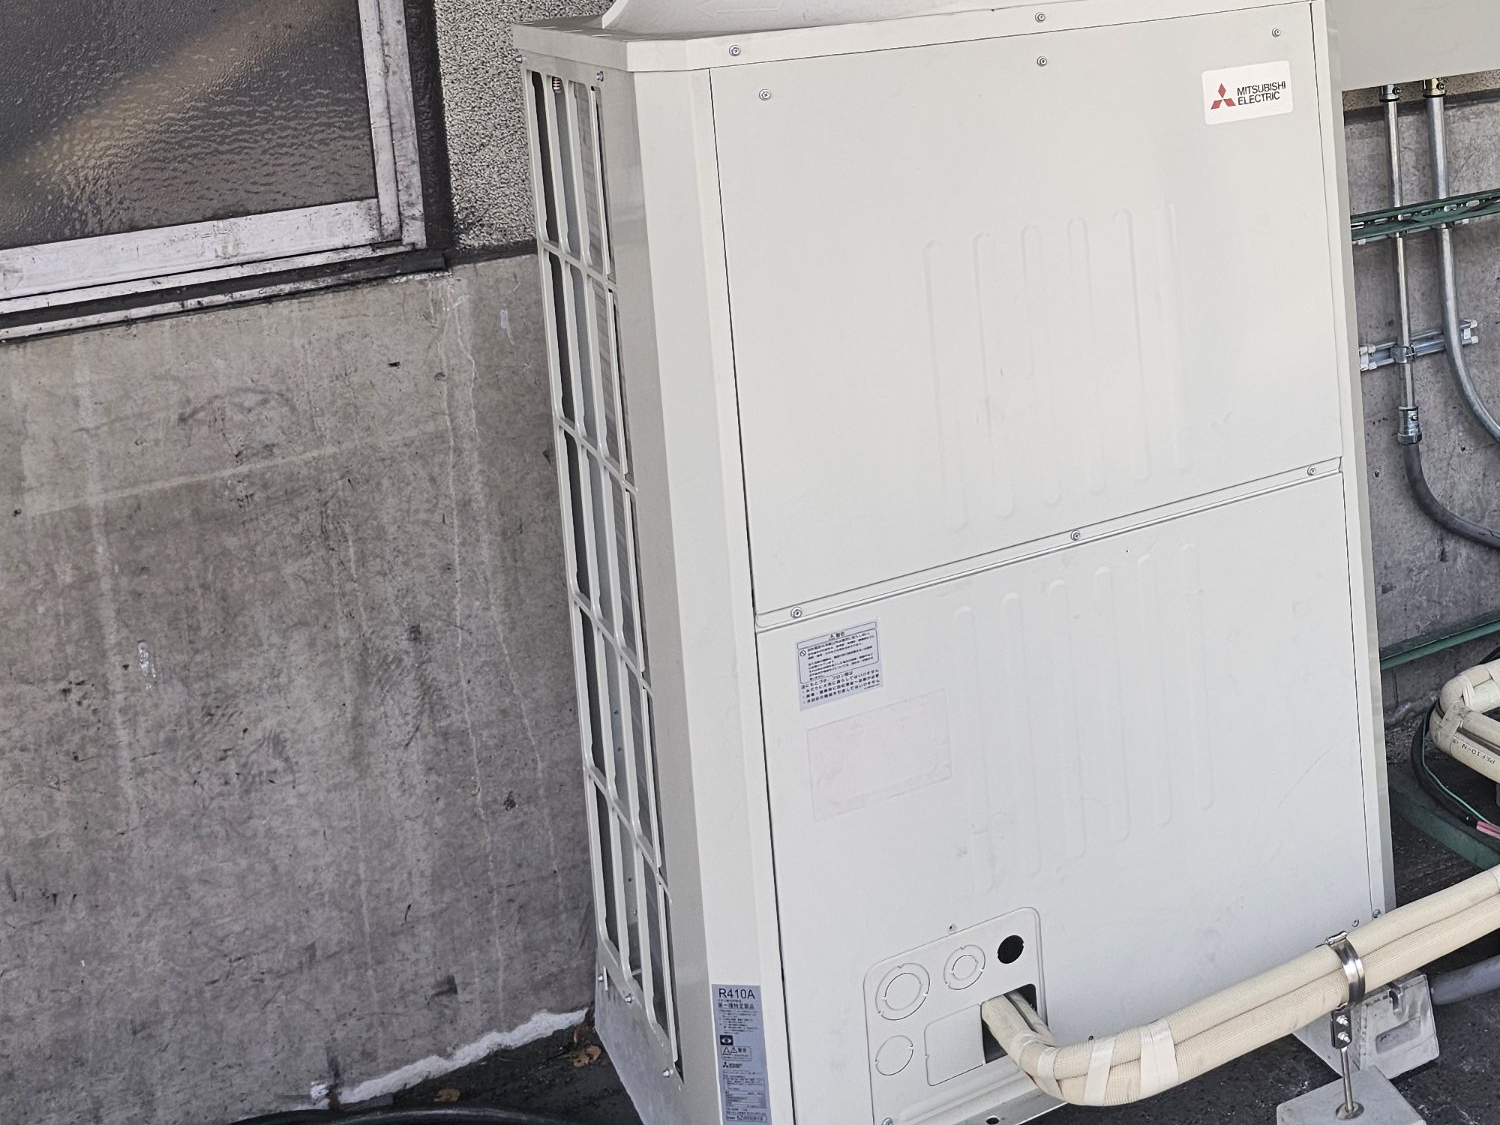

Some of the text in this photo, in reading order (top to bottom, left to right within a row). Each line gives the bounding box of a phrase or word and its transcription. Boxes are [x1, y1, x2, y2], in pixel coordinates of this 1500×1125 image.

[1237, 81, 1286, 96] MITSUBISHI
[1237, 91, 1281, 105] ELECTRIC
[718, 988, 755, 999] R410A
